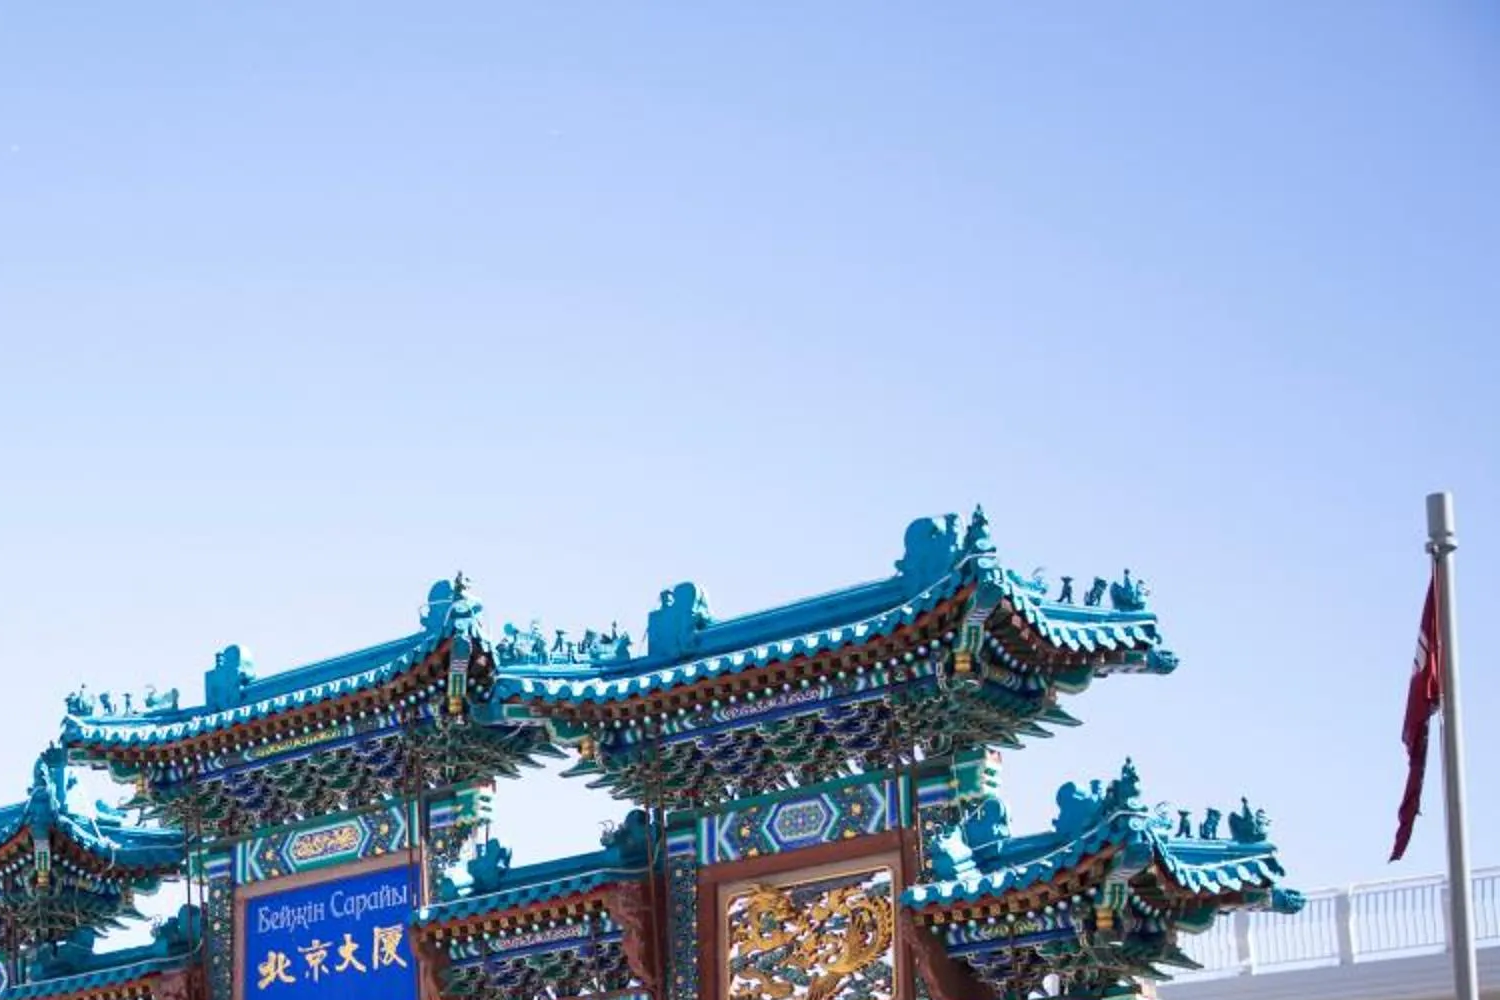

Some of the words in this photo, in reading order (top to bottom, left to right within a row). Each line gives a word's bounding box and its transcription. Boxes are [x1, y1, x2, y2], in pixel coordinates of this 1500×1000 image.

[330, 884, 407, 921] Сарайы
[257, 923, 408, 990] 北京大厦
